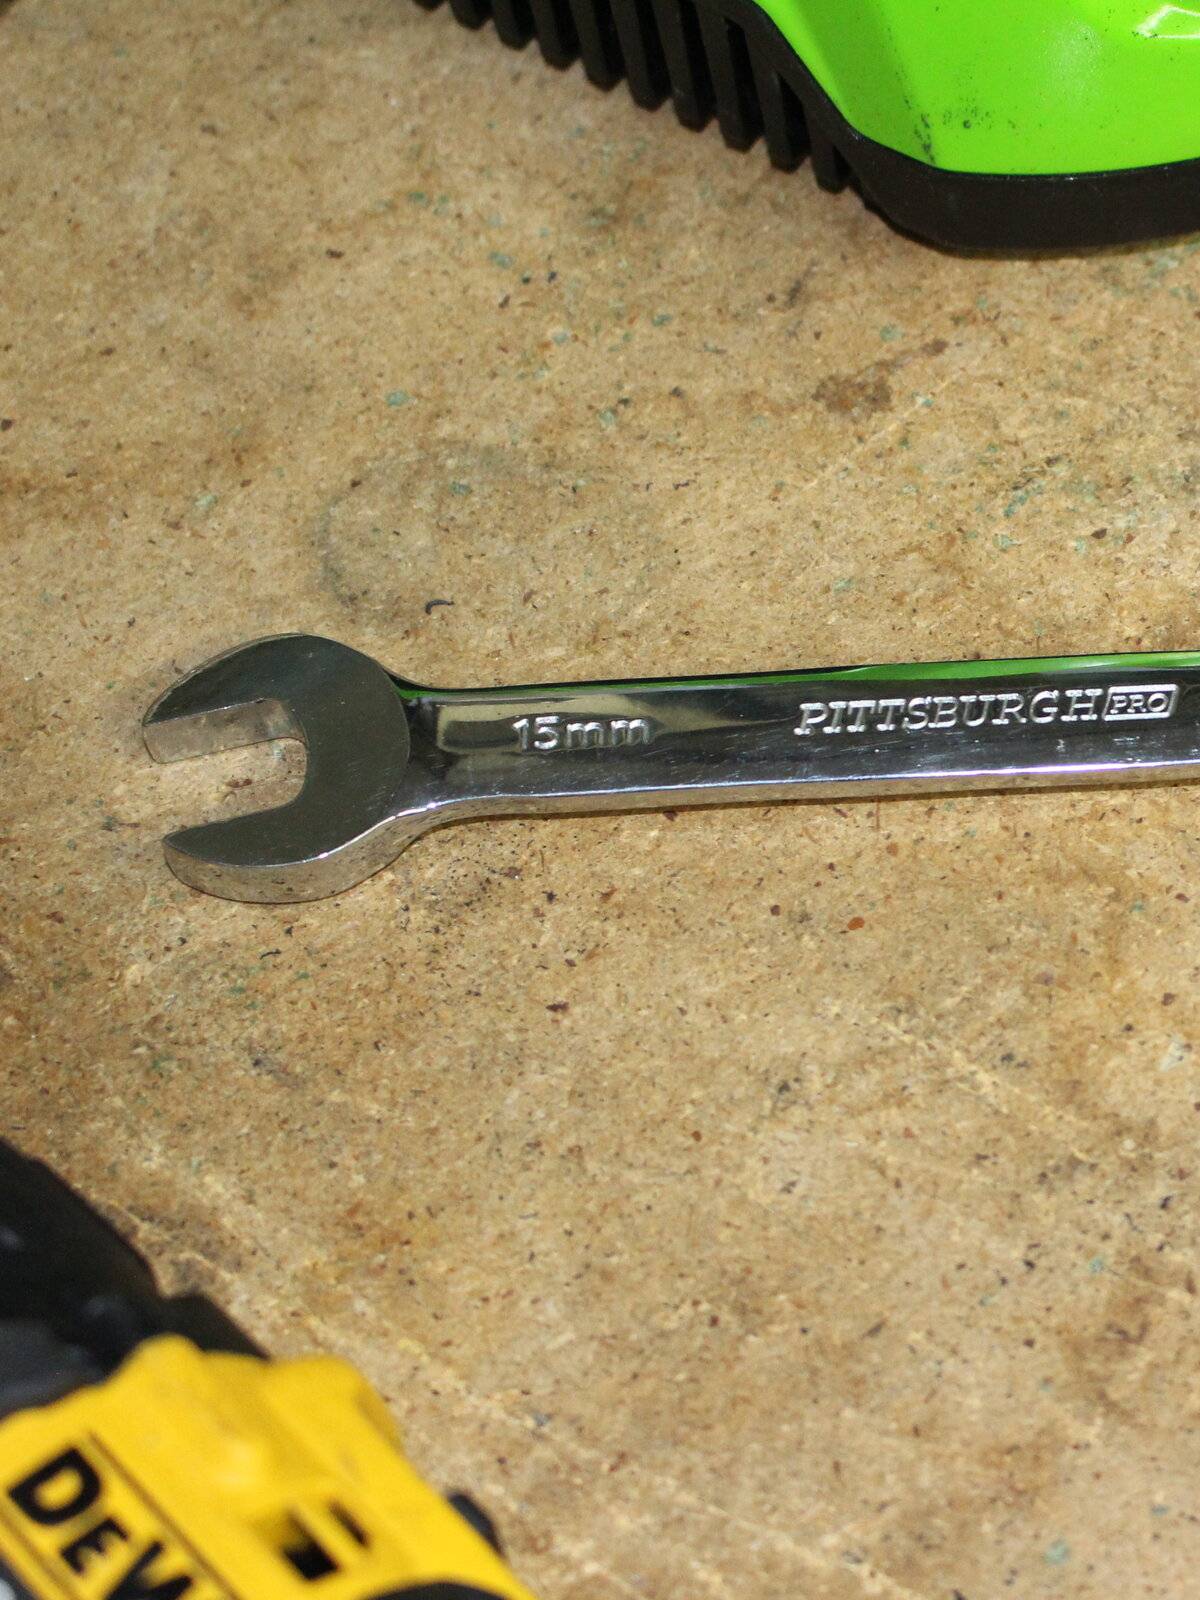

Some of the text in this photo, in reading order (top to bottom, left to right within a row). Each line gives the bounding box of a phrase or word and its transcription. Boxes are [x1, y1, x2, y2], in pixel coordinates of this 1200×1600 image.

[512, 715, 650, 751] 15mm
[793, 688, 1168, 736] PITTSBURGH PRO
